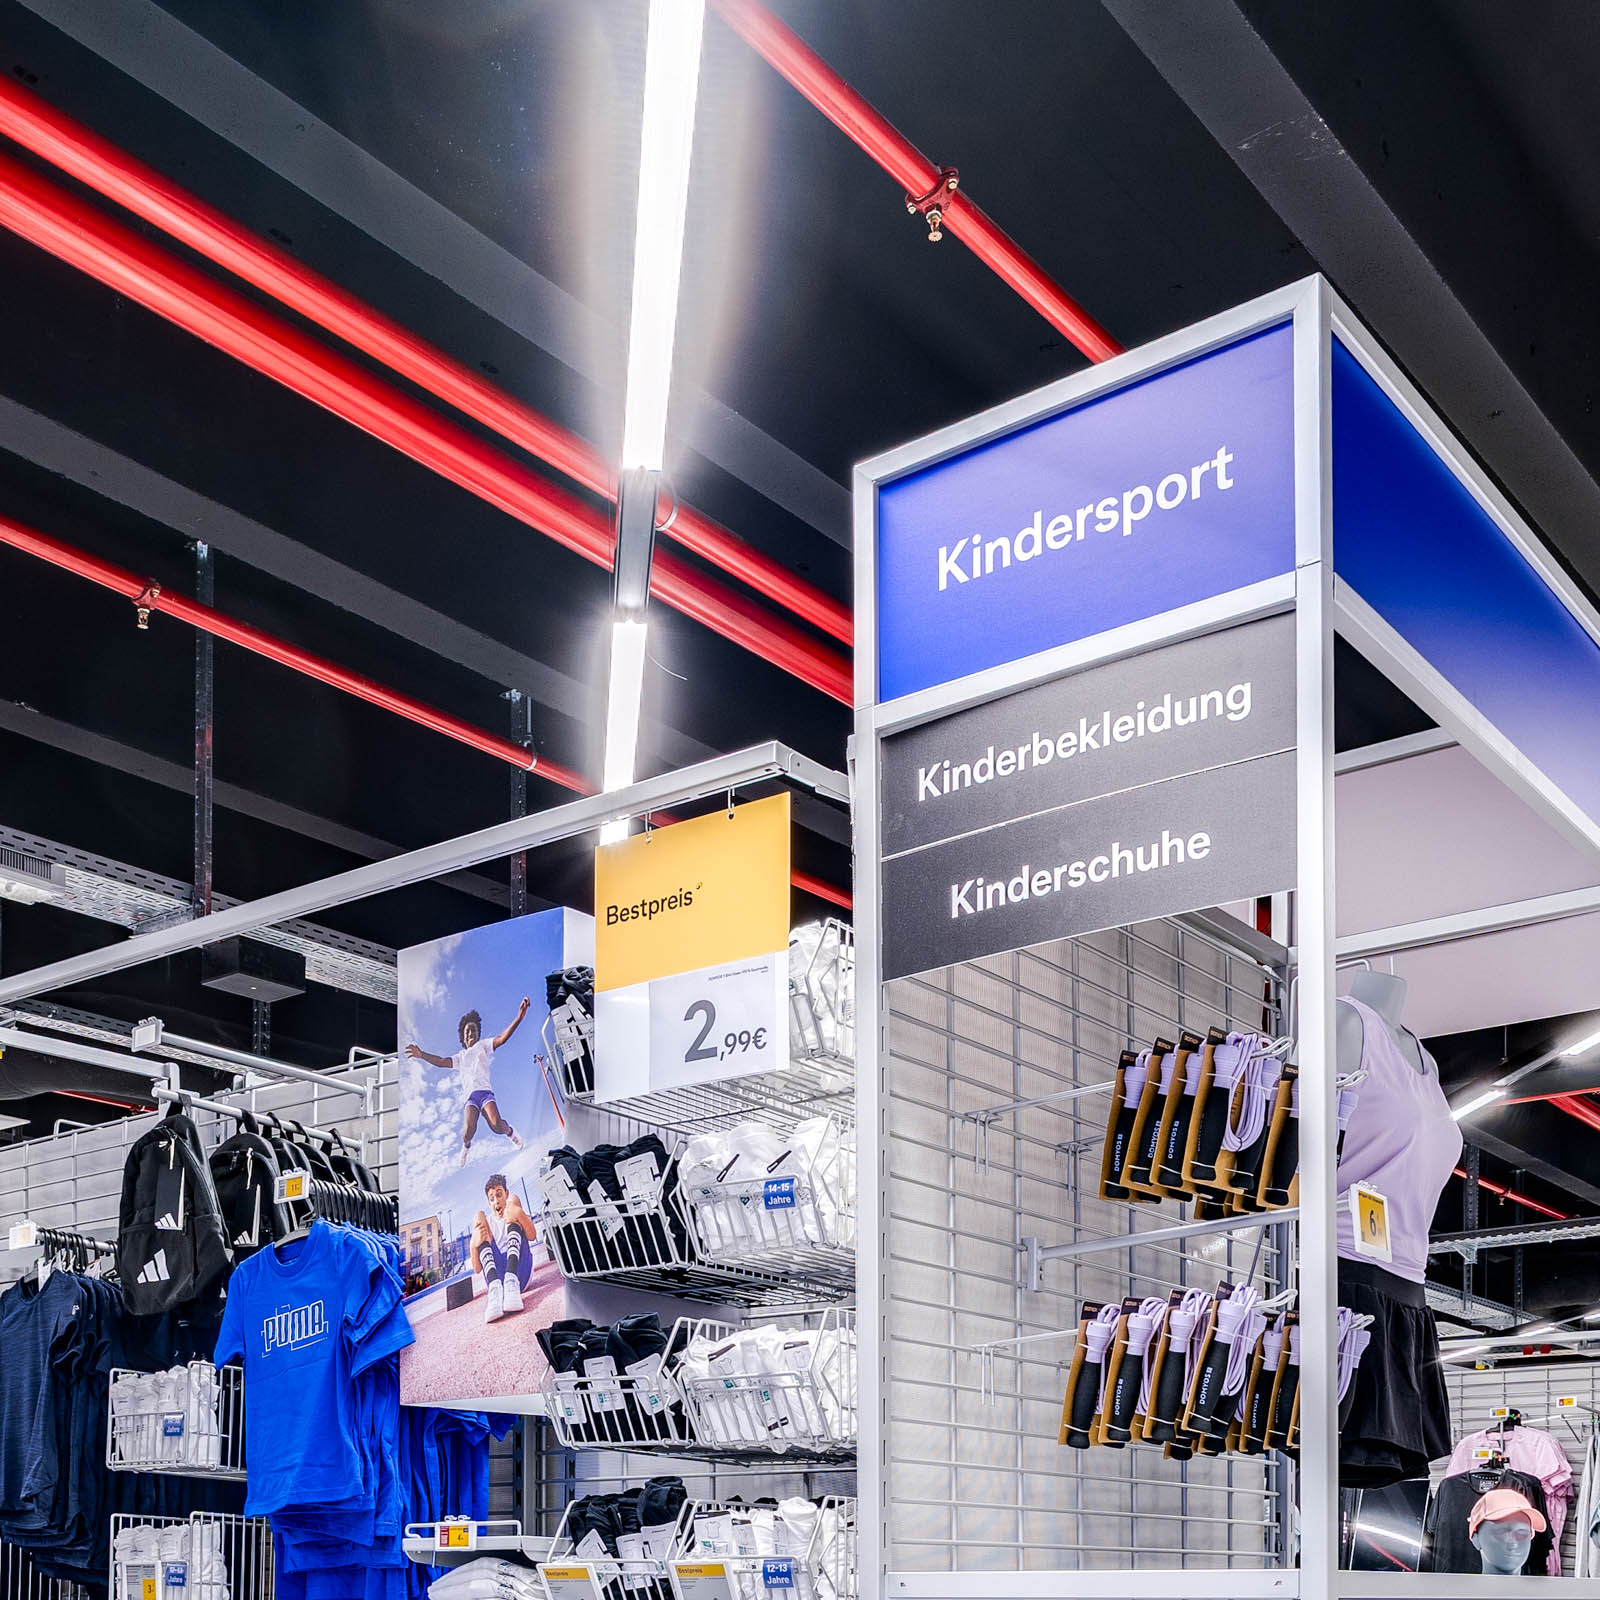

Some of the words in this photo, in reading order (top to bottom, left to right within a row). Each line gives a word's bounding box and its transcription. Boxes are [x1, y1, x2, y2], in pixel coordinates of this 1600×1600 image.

[937, 445, 1234, 592] Kindersport
[918, 681, 1252, 802] Kinderbekleidung
[950, 830, 1211, 919] Kinderschuhe
[606, 887, 693, 926] Bestpreis
[684, 999, 767, 1063] 2,99€
[1114, 1140, 1123, 1172] DOMYOS
[1168, 1127, 1179, 1159] DOMYOS
[768, 1182, 790, 1193] 14-15
[768, 1195, 791, 1205] Jahre
[263, 1299, 325, 1352] PUMA
[1114, 1385, 1123, 1415] DOMYOS
[1199, 1373, 1213, 1405] DOMYOS
[766, 1563, 788, 1573] 12-13
[767, 1575, 789, 1585] Jahre
